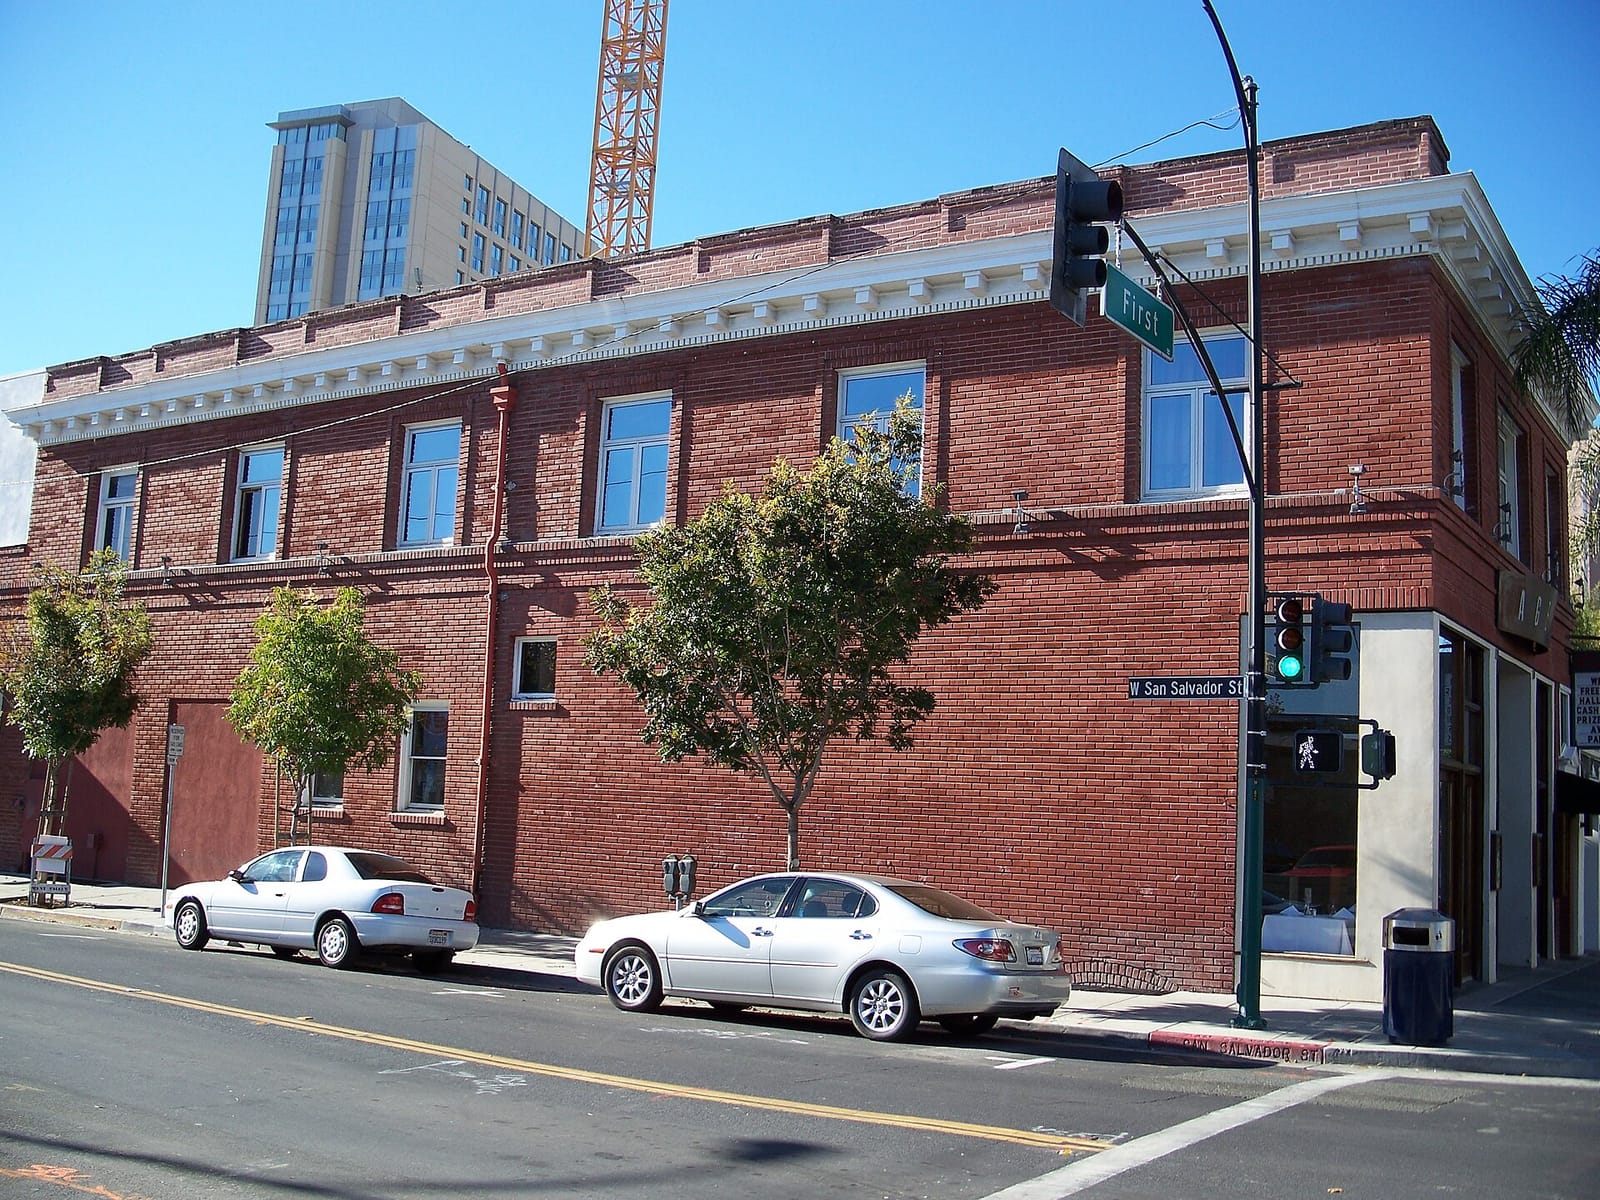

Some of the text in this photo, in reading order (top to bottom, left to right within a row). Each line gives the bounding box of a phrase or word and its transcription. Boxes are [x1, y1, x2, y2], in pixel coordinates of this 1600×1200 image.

[1122, 287, 1159, 337] First
[1129, 679, 1243, 696] W San Salvador St
[1580, 687, 1600, 695] FREE
[1576, 705, 1599, 715] CASH
[1219, 1041, 1291, 1062] SALVADOR
[1300, 1048, 1320, 1062] ST
